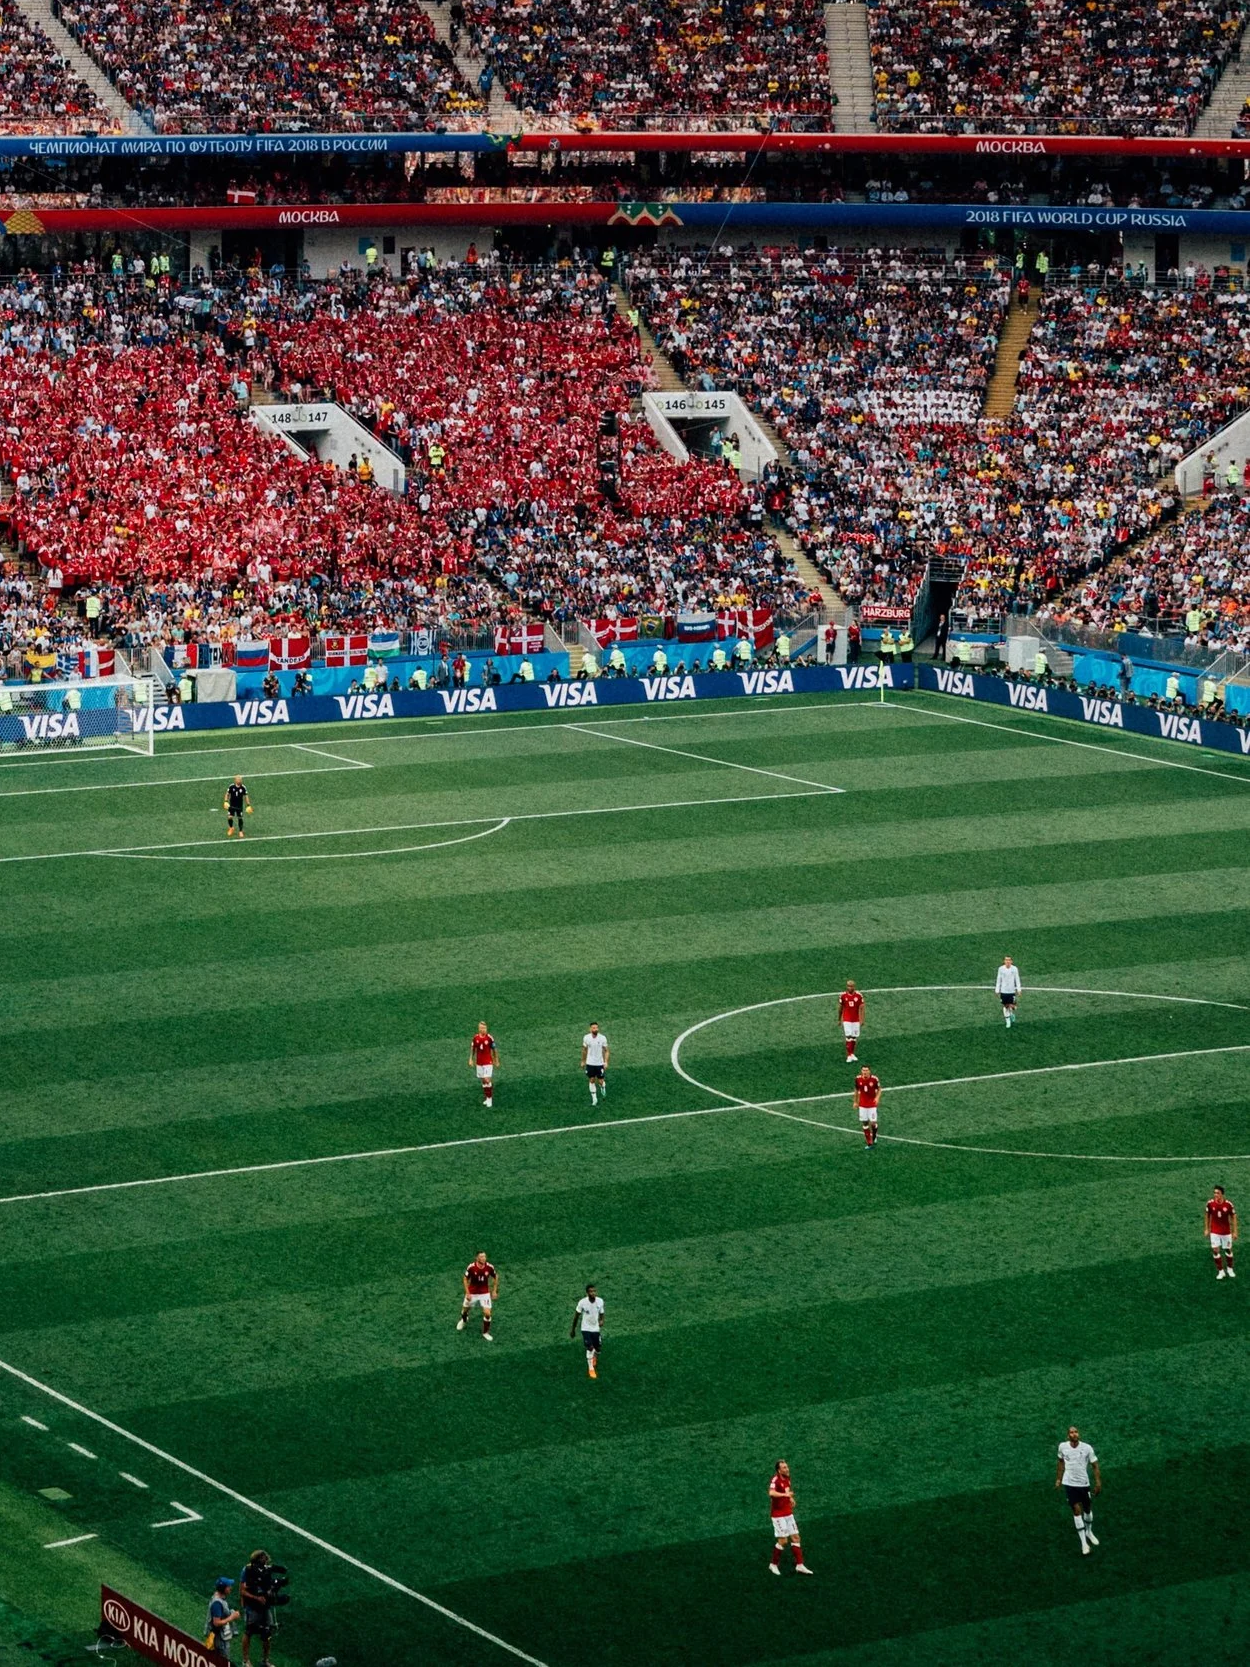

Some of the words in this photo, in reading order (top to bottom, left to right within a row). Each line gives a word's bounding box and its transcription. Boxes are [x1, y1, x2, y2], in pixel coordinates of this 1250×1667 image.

[29, 141, 117, 154] ЧЕМПИОНАТ
[121, 141, 162, 153] МИРА
[166, 141, 186, 152] ПО
[189, 140, 252, 153] ФУТБОЛУ
[257, 140, 284, 152] FIFA
[288, 140, 318, 152] 2018
[322, 140, 331, 151] В
[333, 139, 387, 151] РОССИИ
[976, 140, 1046, 154] МОСКВА
[278, 210, 340, 223] МОСКВА
[966, 211, 999, 223] 2018
[1003, 211, 1035, 223] FIFA
[1037, 212, 1092, 224] WORLD
[1096, 212, 1128, 225] CUP
[1131, 213, 1187, 227] RUSSIA
[308, 411, 328, 422] 147
[665, 399, 686, 410] 146
[704, 399, 725, 409] 145
[272, 413, 292, 424] 148
[863, 607, 911, 619] HARZBURG
[639, 675, 696, 701] VISA
[736, 670, 794, 695] VISA
[836, 665, 894, 689] VISA
[933, 668, 974, 698] VISA
[333, 693, 395, 719] VISA
[437, 687, 497, 713] VISA
[539, 681, 598, 706] VISA
[1005, 682, 1048, 712] VISA
[126, 706, 185, 733] VISA
[228, 699, 290, 726] VISA
[1079, 696, 1123, 728] VISA
[18, 713, 81, 740] VISA
[1155, 712, 1202, 744] VISA
[108, 1603, 127, 1628] KIA
[133, 1615, 160, 1652] KIA
[163, 1634, 216, 1667] MOTO
